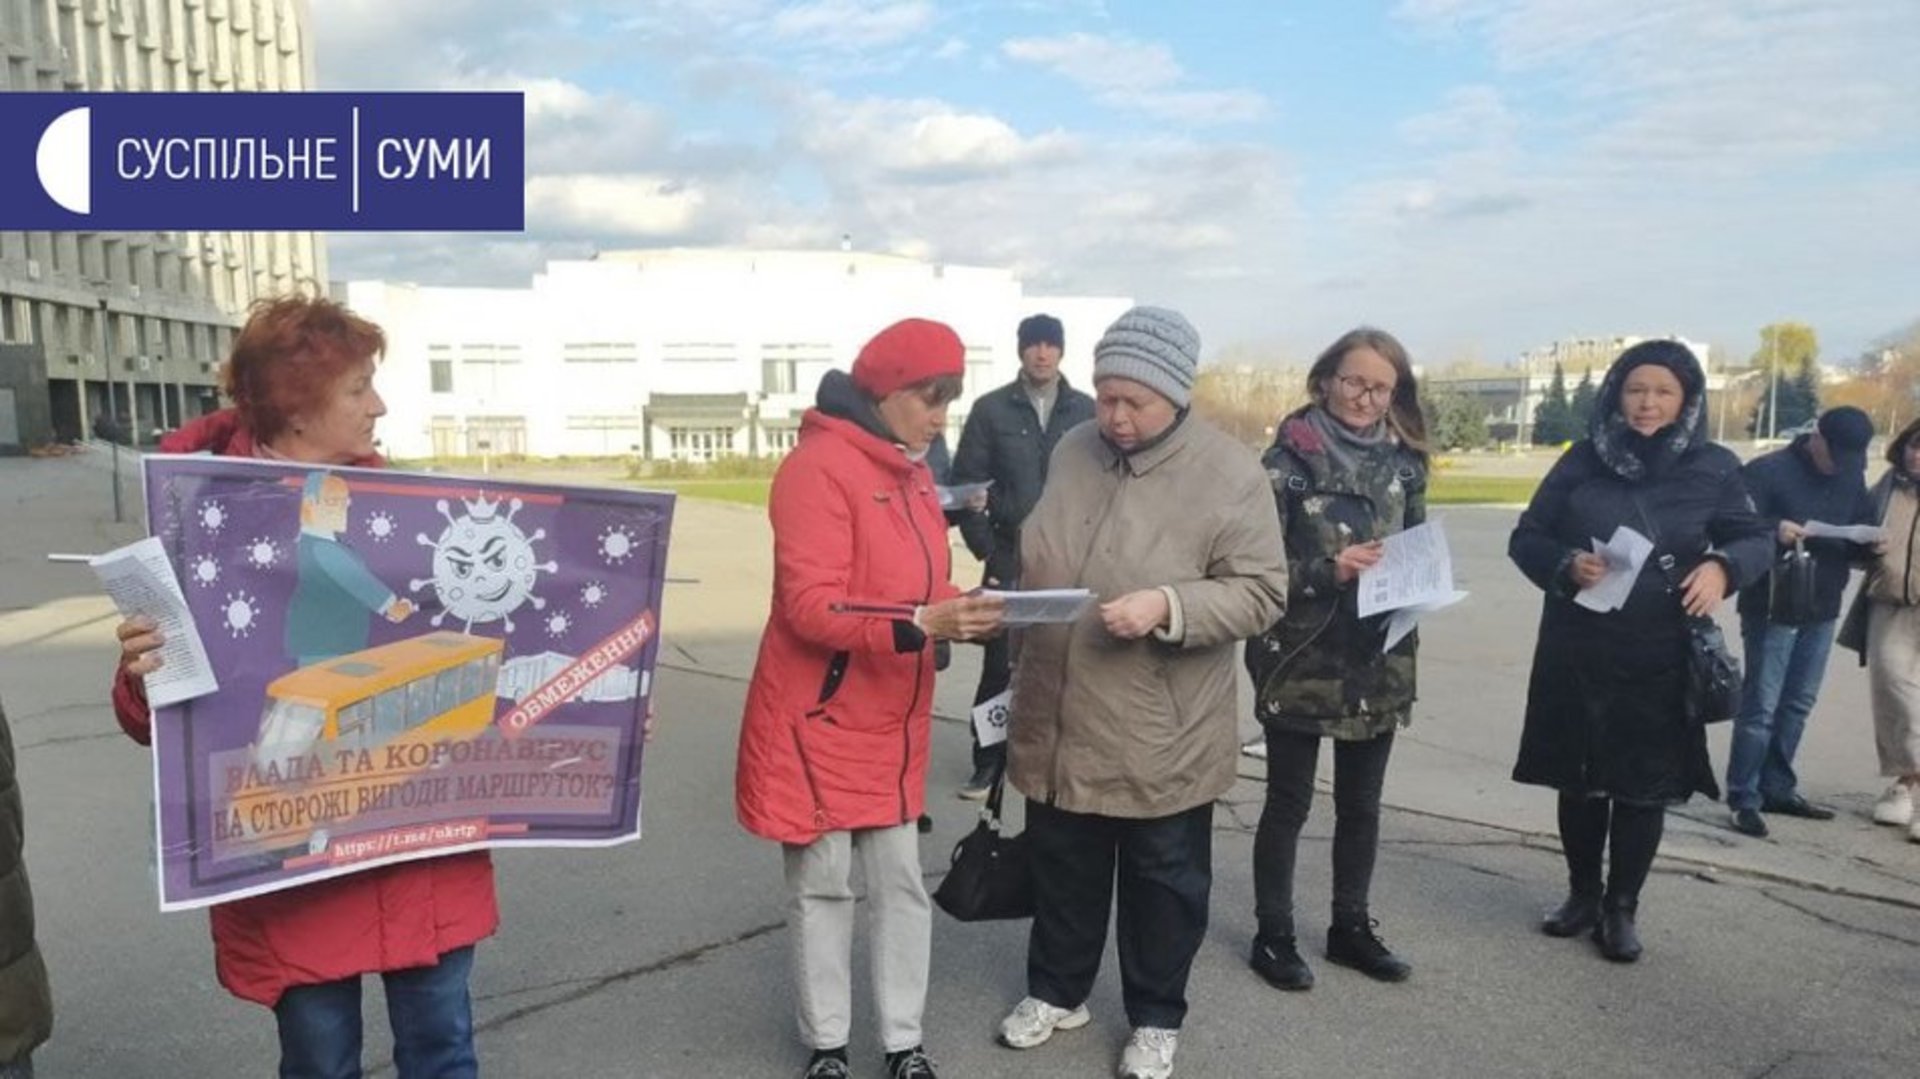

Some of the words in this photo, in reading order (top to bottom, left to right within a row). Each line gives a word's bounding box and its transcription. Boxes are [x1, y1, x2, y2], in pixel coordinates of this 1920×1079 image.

[510, 619, 649, 729] ОБМЕЖЕННЯ
[225, 752, 326, 793] ВЛАДА
[336, 748, 374, 775] ТА
[385, 737, 608, 769] КОРОНАВІРУС
[214, 808, 245, 841] НА
[251, 789, 350, 833] СТОРОЖІ
[357, 777, 448, 815] ВИГОДИ
[455, 771, 615, 801] МАРШРУТОК?
